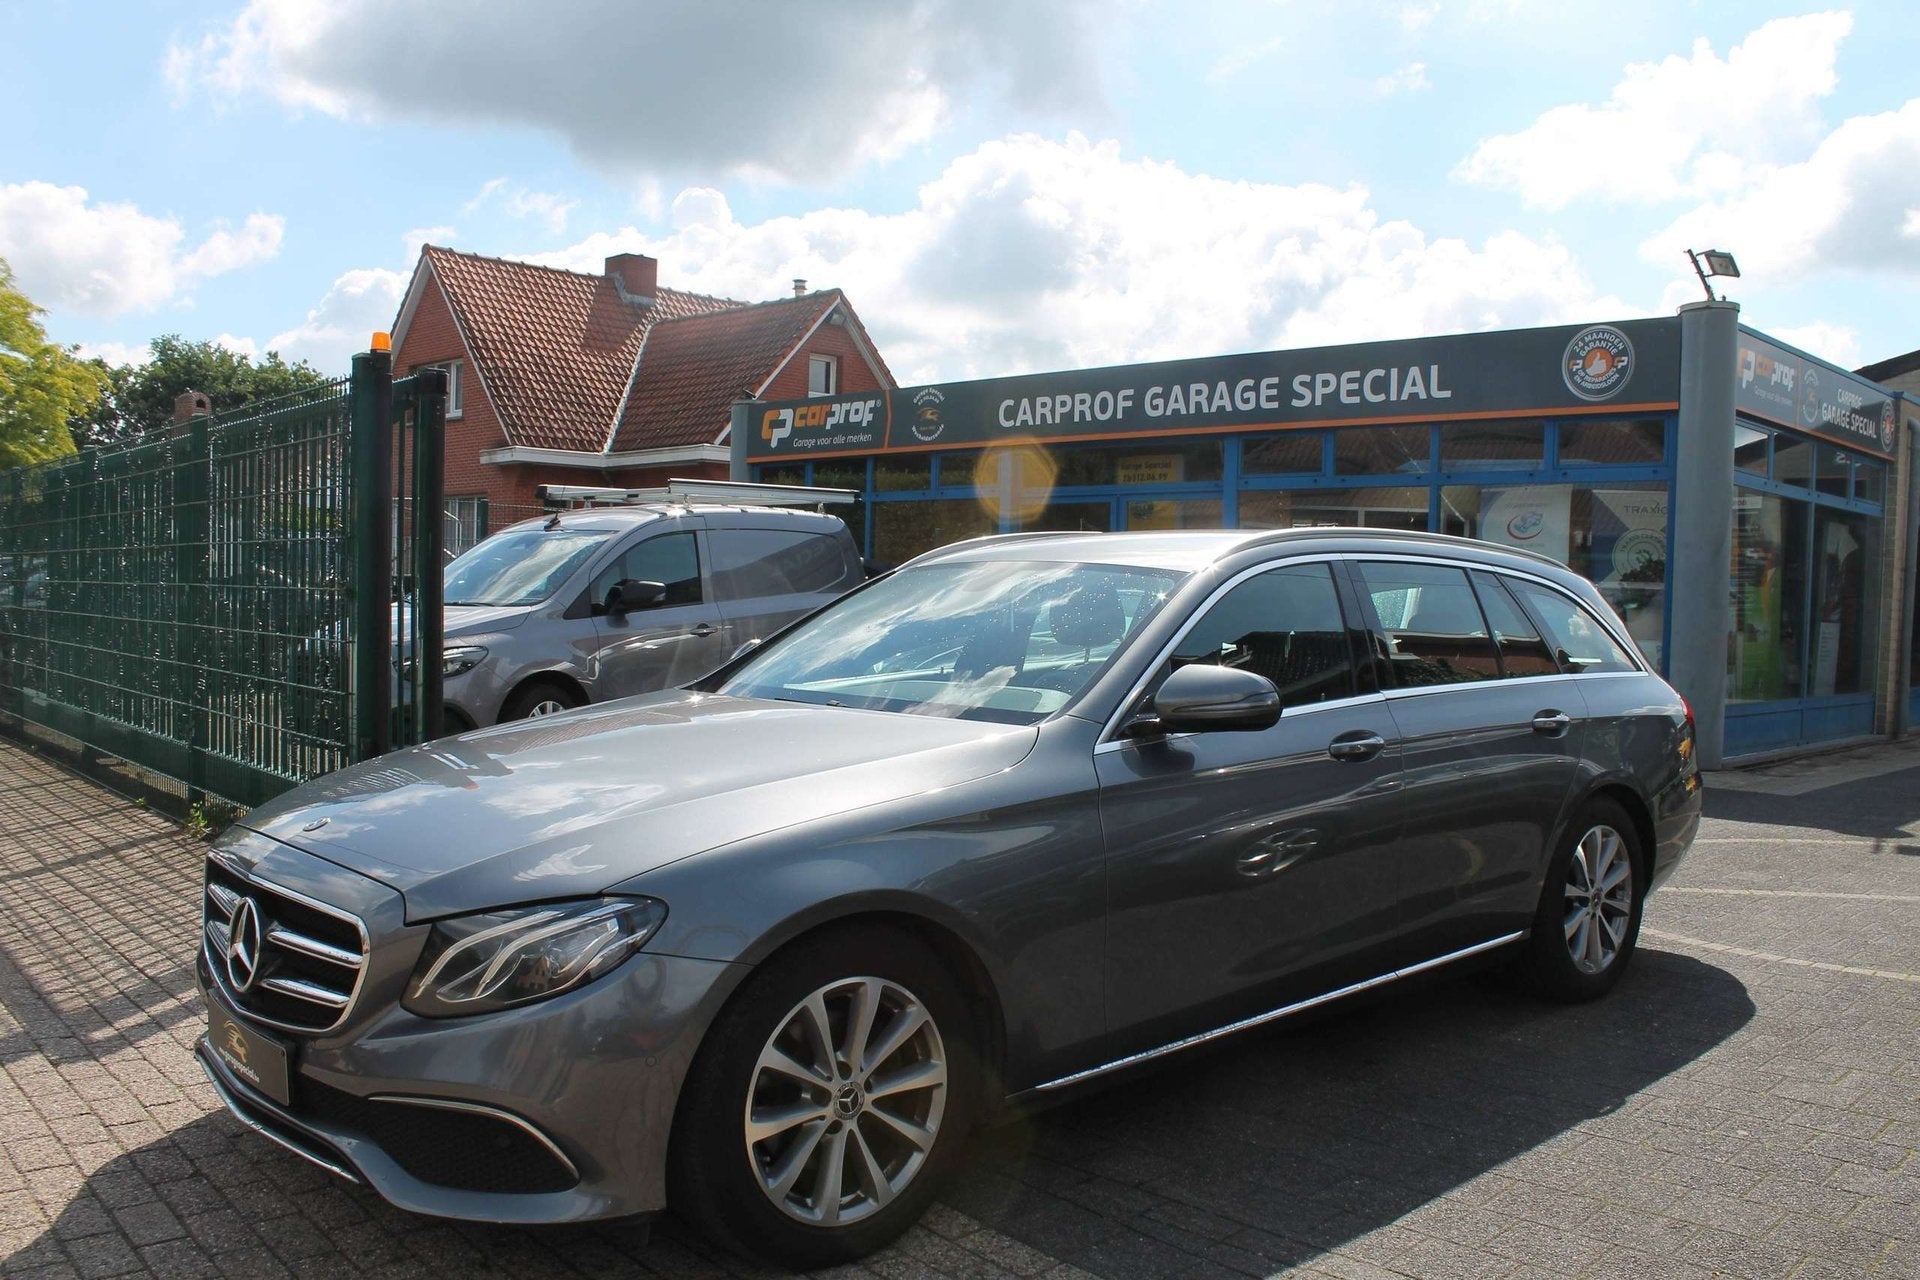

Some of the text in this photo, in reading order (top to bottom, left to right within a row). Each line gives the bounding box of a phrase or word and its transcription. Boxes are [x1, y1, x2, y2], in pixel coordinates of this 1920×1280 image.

[1573, 332, 1625, 353] 24 MAANDEN
[1580, 341, 1618, 357] GARANTIE
[998, 364, 1452, 428] CARPROF GARAGE SPECIAL
[794, 400, 876, 431] carprof
[1821, 402, 1850, 430] GARAGE
[1850, 413, 1877, 439] SPECIAL
[793, 433, 872, 448] Garage voor alle merken
